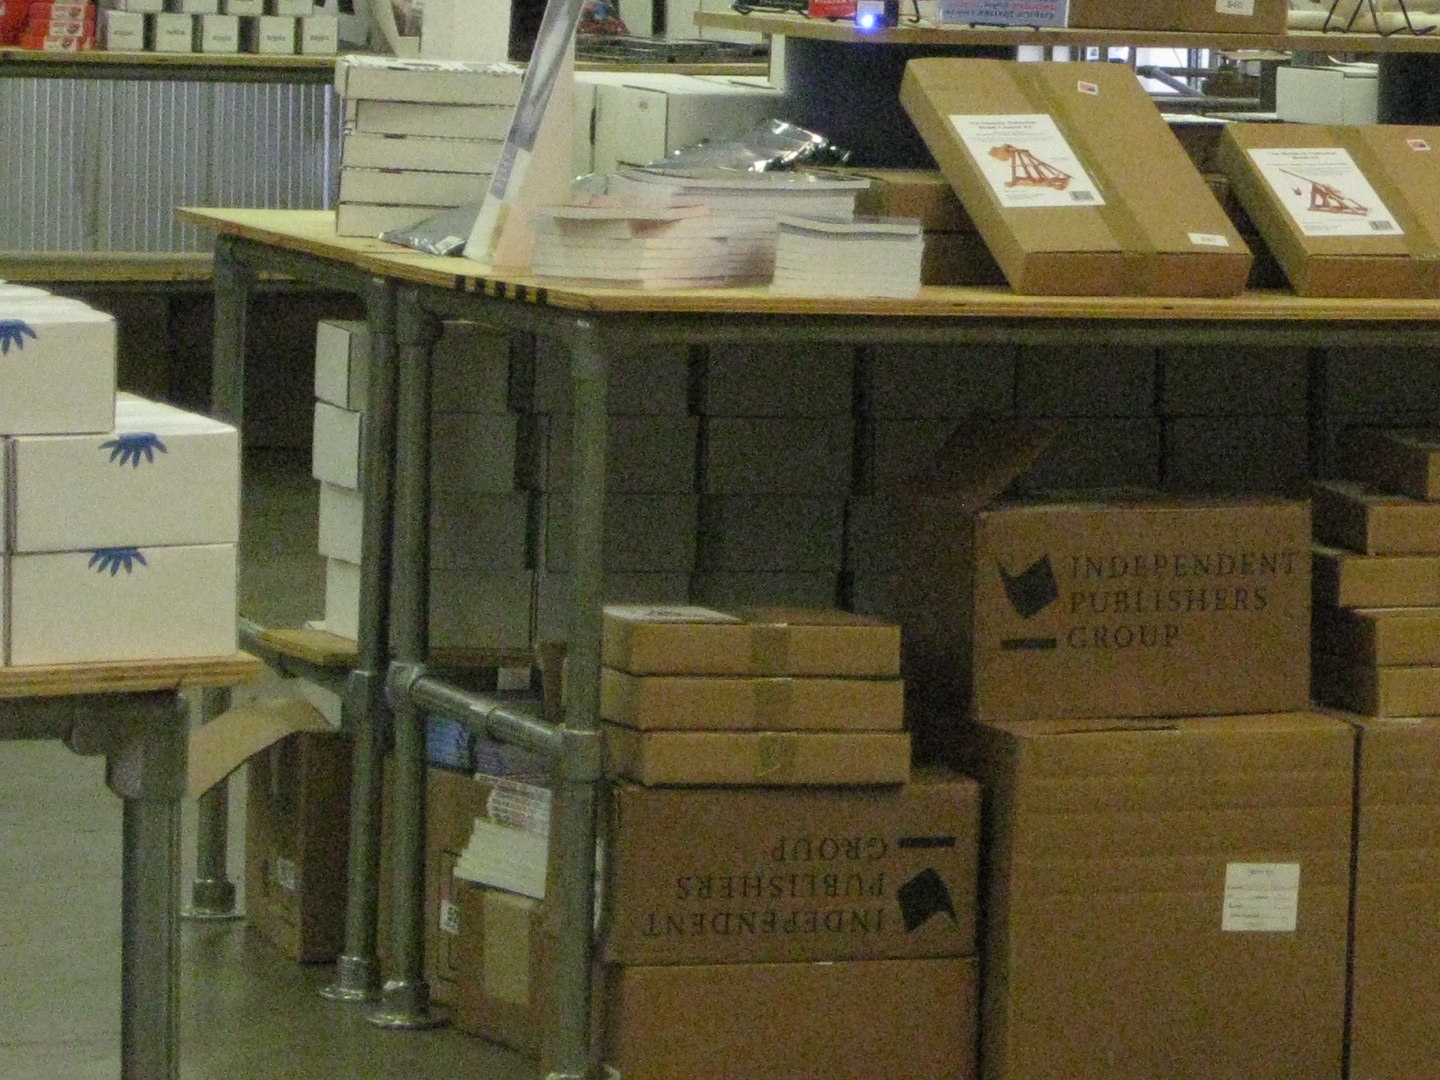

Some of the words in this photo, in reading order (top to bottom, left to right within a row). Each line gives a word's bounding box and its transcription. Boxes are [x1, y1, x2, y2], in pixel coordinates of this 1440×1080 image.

[1071, 553, 1298, 577] INDEPENDENT
[1070, 588, 1269, 613] PUBLISHERS
[1068, 625, 1181, 649] GROUP
[772, 836, 890, 863] GROUP
[676, 874, 886, 900] PUBLISHERS
[643, 909, 885, 937] INDEPENDENT
